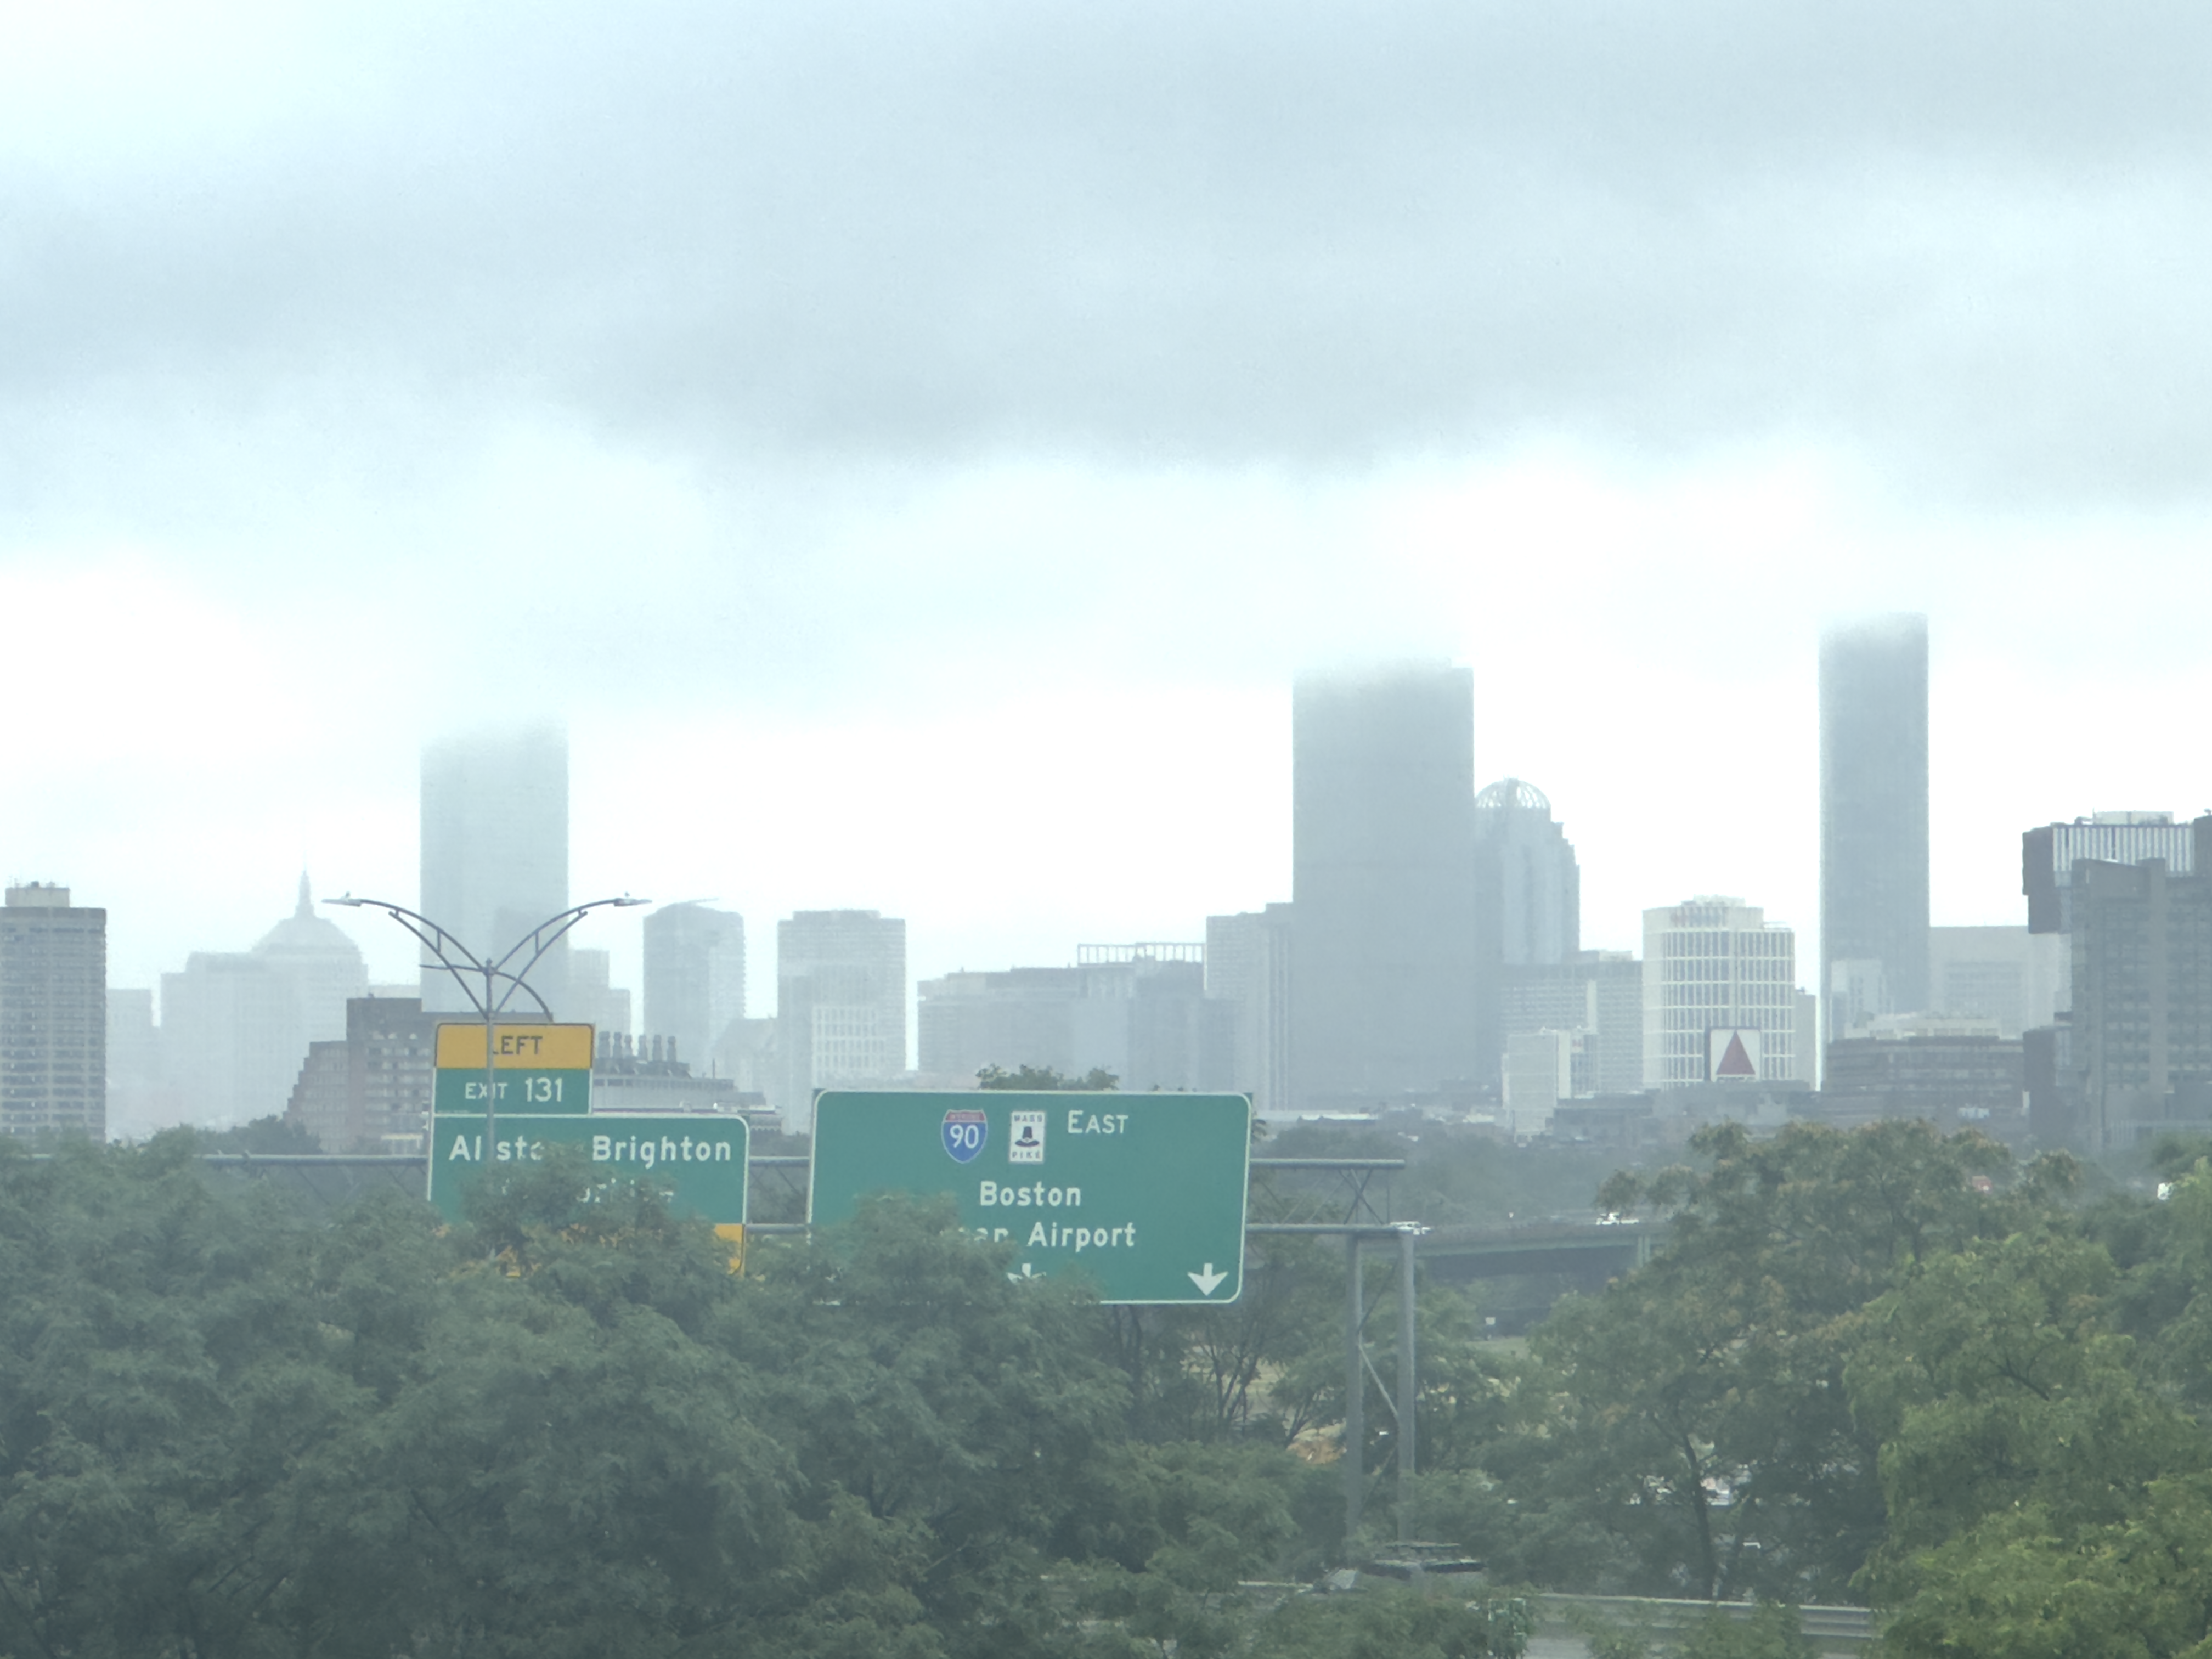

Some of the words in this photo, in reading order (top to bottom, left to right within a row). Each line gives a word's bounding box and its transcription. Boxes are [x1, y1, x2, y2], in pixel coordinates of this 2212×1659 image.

[465, 1082, 508, 1099] EXIT
[525, 1077, 562, 1102] 131
[1068, 1109, 1129, 1134] EAST
[950, 1124, 979, 1149] 90
[592, 1135, 731, 1170] Brighton
[1012, 1151, 1040, 1159] PIKE
[980, 1180, 1081, 1206] Boston
[1026, 1221, 1136, 1253] Airport
